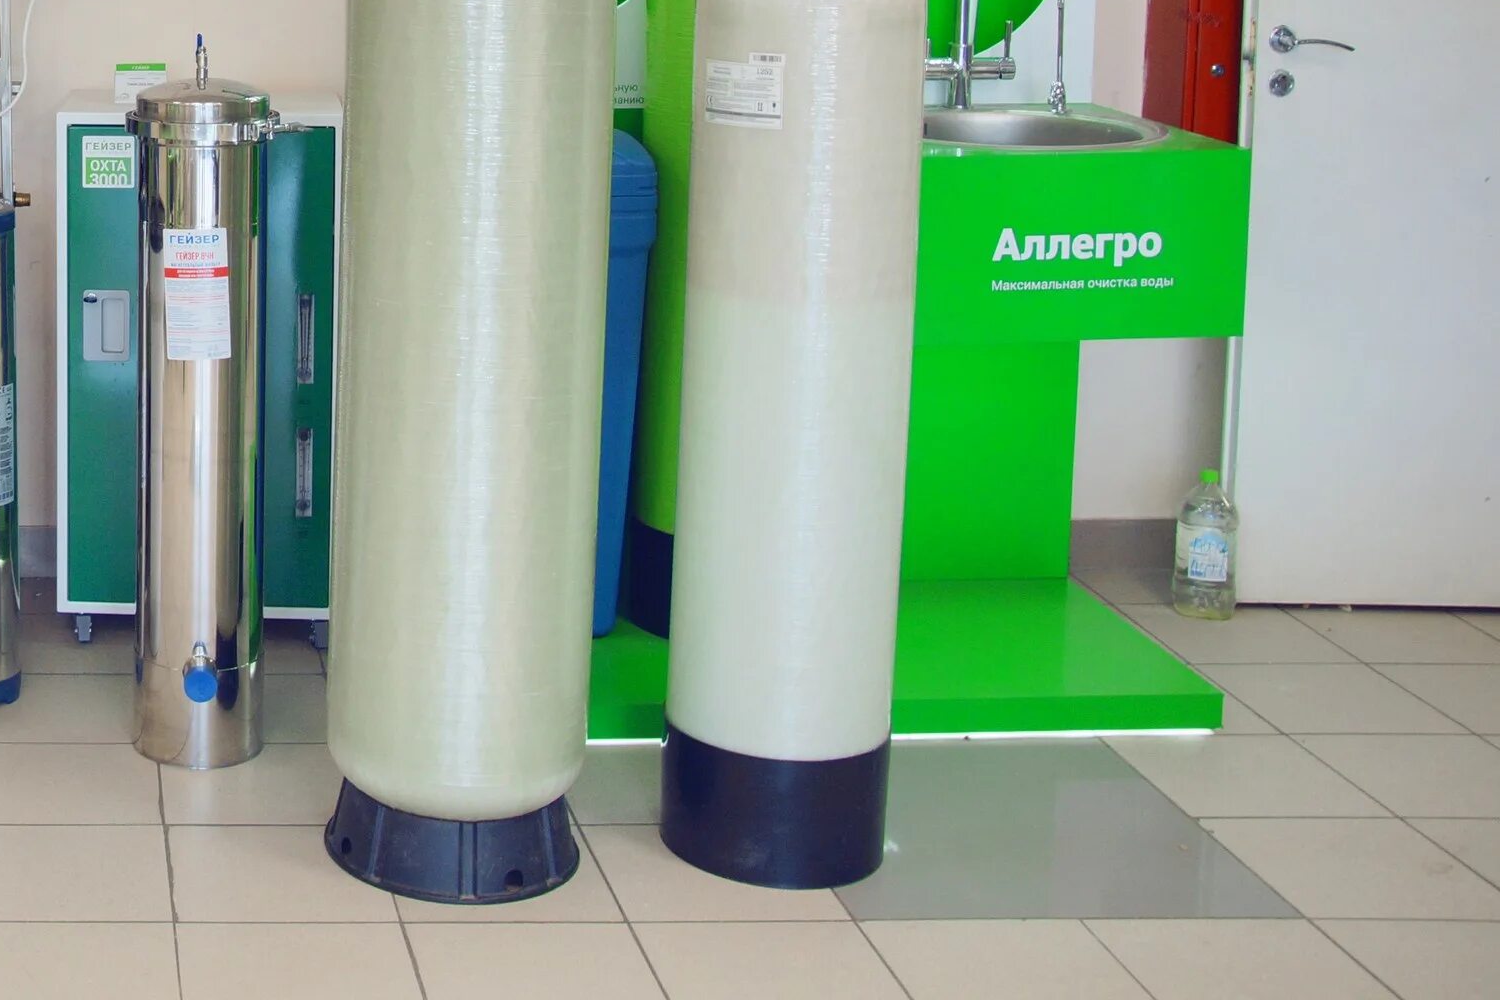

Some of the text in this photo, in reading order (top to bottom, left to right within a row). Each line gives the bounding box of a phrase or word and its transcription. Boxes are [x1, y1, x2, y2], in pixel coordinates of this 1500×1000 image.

[85, 140, 132, 151] ГЕЙЗЕР
[90, 159, 127, 172] ОХТА
[90, 172, 128, 186] 3000
[169, 232, 220, 244] ГЕЙЗЕР
[992, 227, 1163, 267] Аллегро
[991, 276, 1174, 292] Максимальная очистка воды
